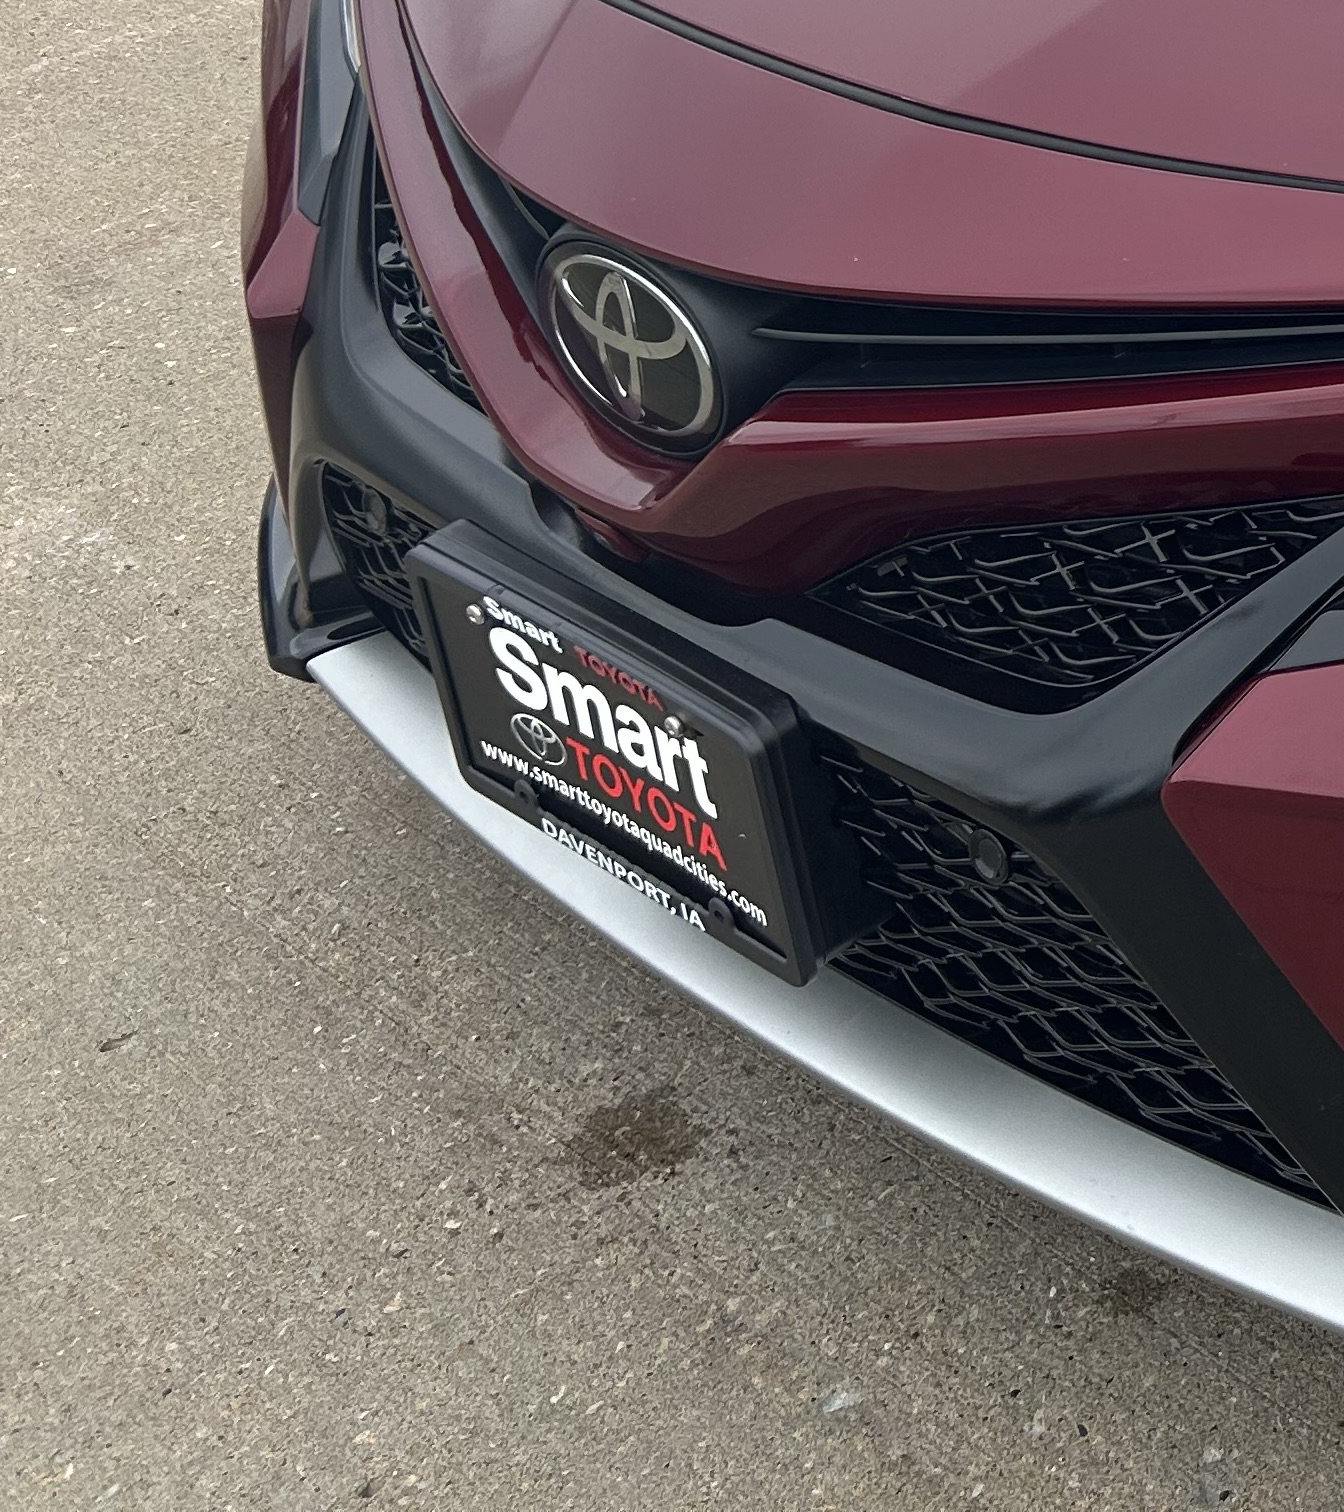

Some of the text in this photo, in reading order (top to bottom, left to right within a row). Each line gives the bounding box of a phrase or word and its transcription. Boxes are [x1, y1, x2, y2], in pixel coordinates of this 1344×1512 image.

[482, 595, 564, 654] Smart
[574, 645, 664, 711] TOYOTA
[488, 627, 718, 820] Smart
[480, 739, 768, 928] www.smarttoyotaquadcities.com
[566, 736, 728, 872] TOYOTA
[540, 817, 706, 932] DAVENPORT, IA
